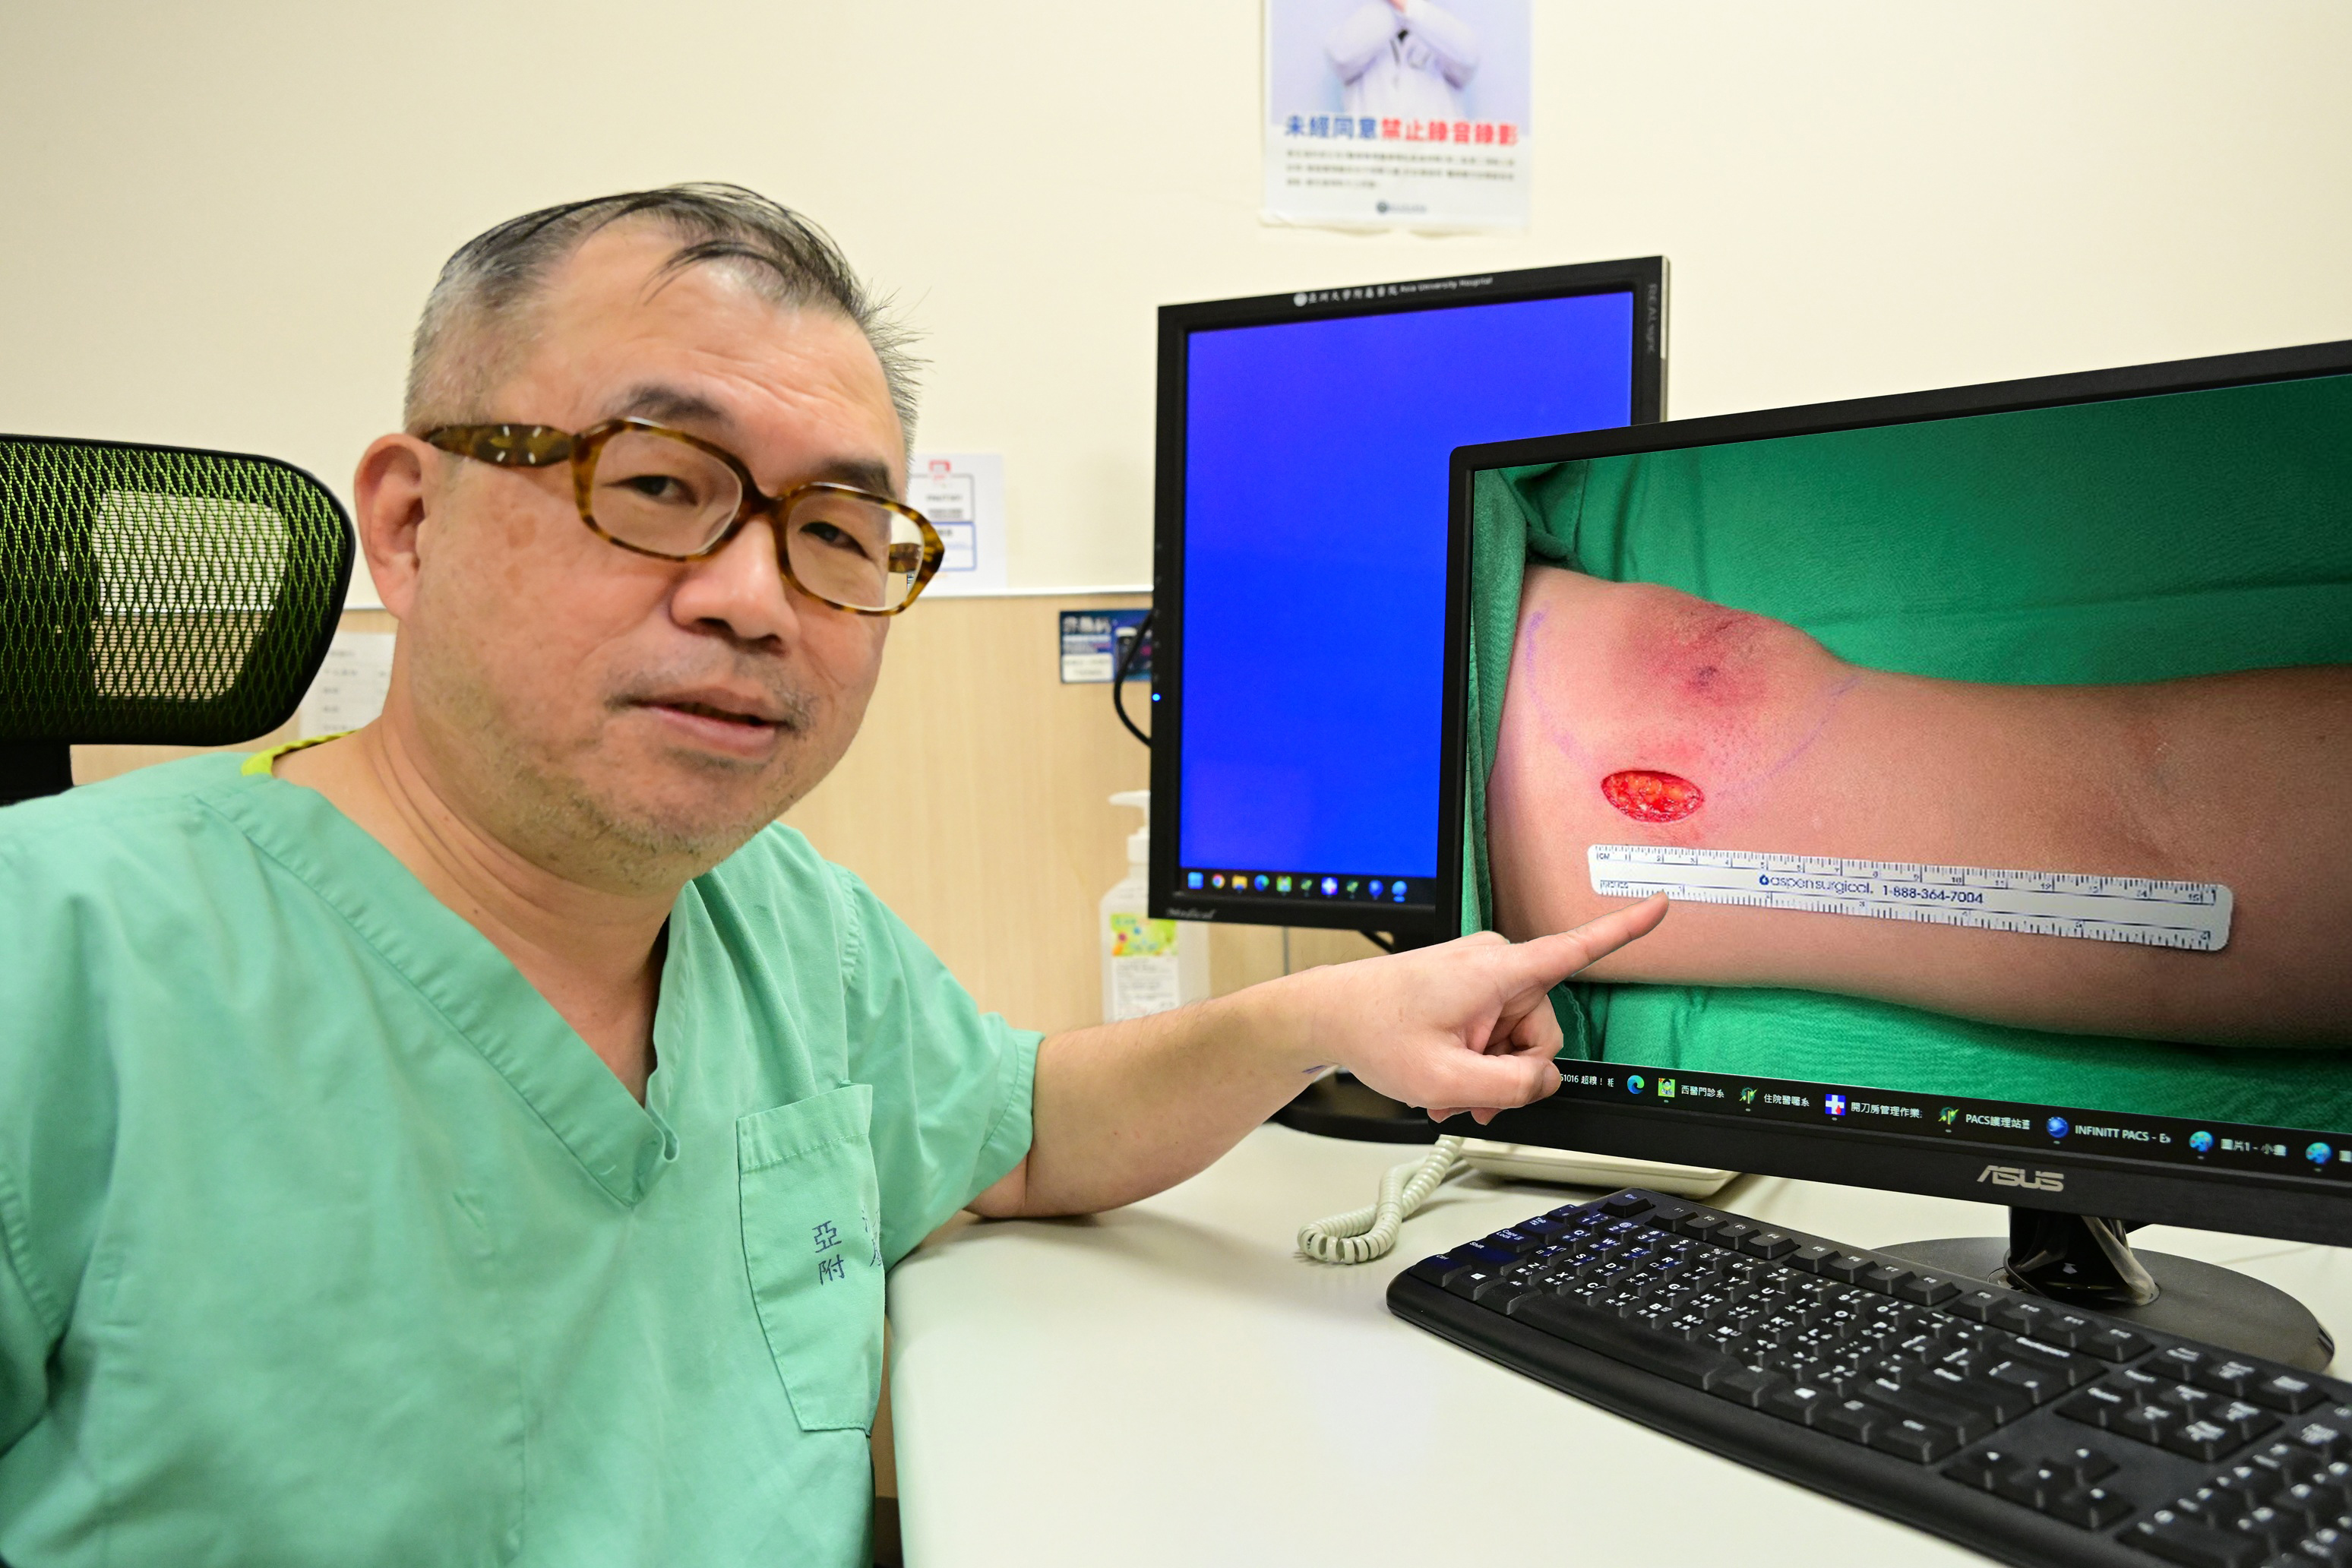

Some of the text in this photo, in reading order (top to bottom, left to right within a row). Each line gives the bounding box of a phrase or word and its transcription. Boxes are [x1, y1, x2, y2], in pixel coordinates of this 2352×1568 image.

[1851, 1102, 1923, 1118] 開刀房管理作業
[2075, 1124, 2120, 1138] INFINITT
[2122, 1129, 2149, 1141] PACS
[1977, 1165, 2065, 1192] ASUS
